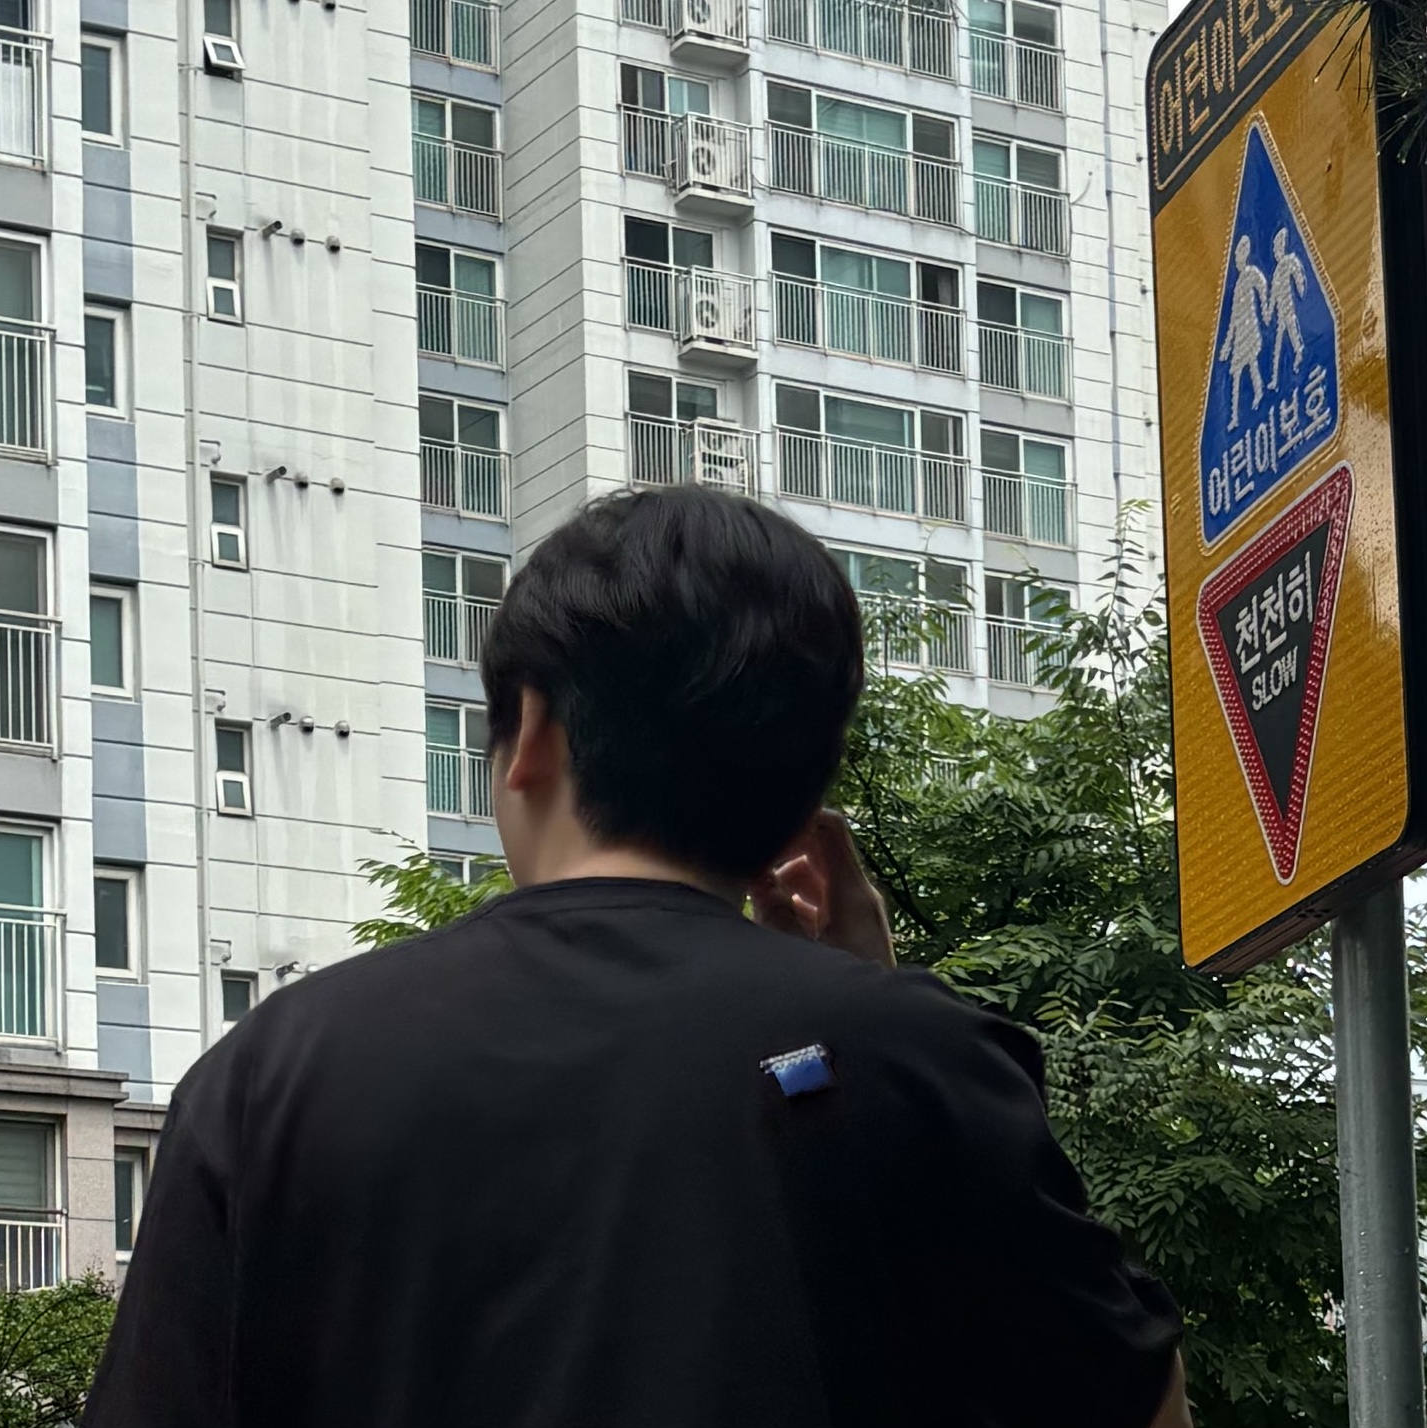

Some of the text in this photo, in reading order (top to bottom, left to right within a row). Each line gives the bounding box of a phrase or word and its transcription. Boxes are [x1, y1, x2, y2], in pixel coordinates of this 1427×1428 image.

[1159, 0, 1294, 155] 어린이보
[1208, 365, 1332, 516] 어린이보호
[1235, 551, 1313, 674] 천천히
[1251, 645, 1298, 711] SLOW
